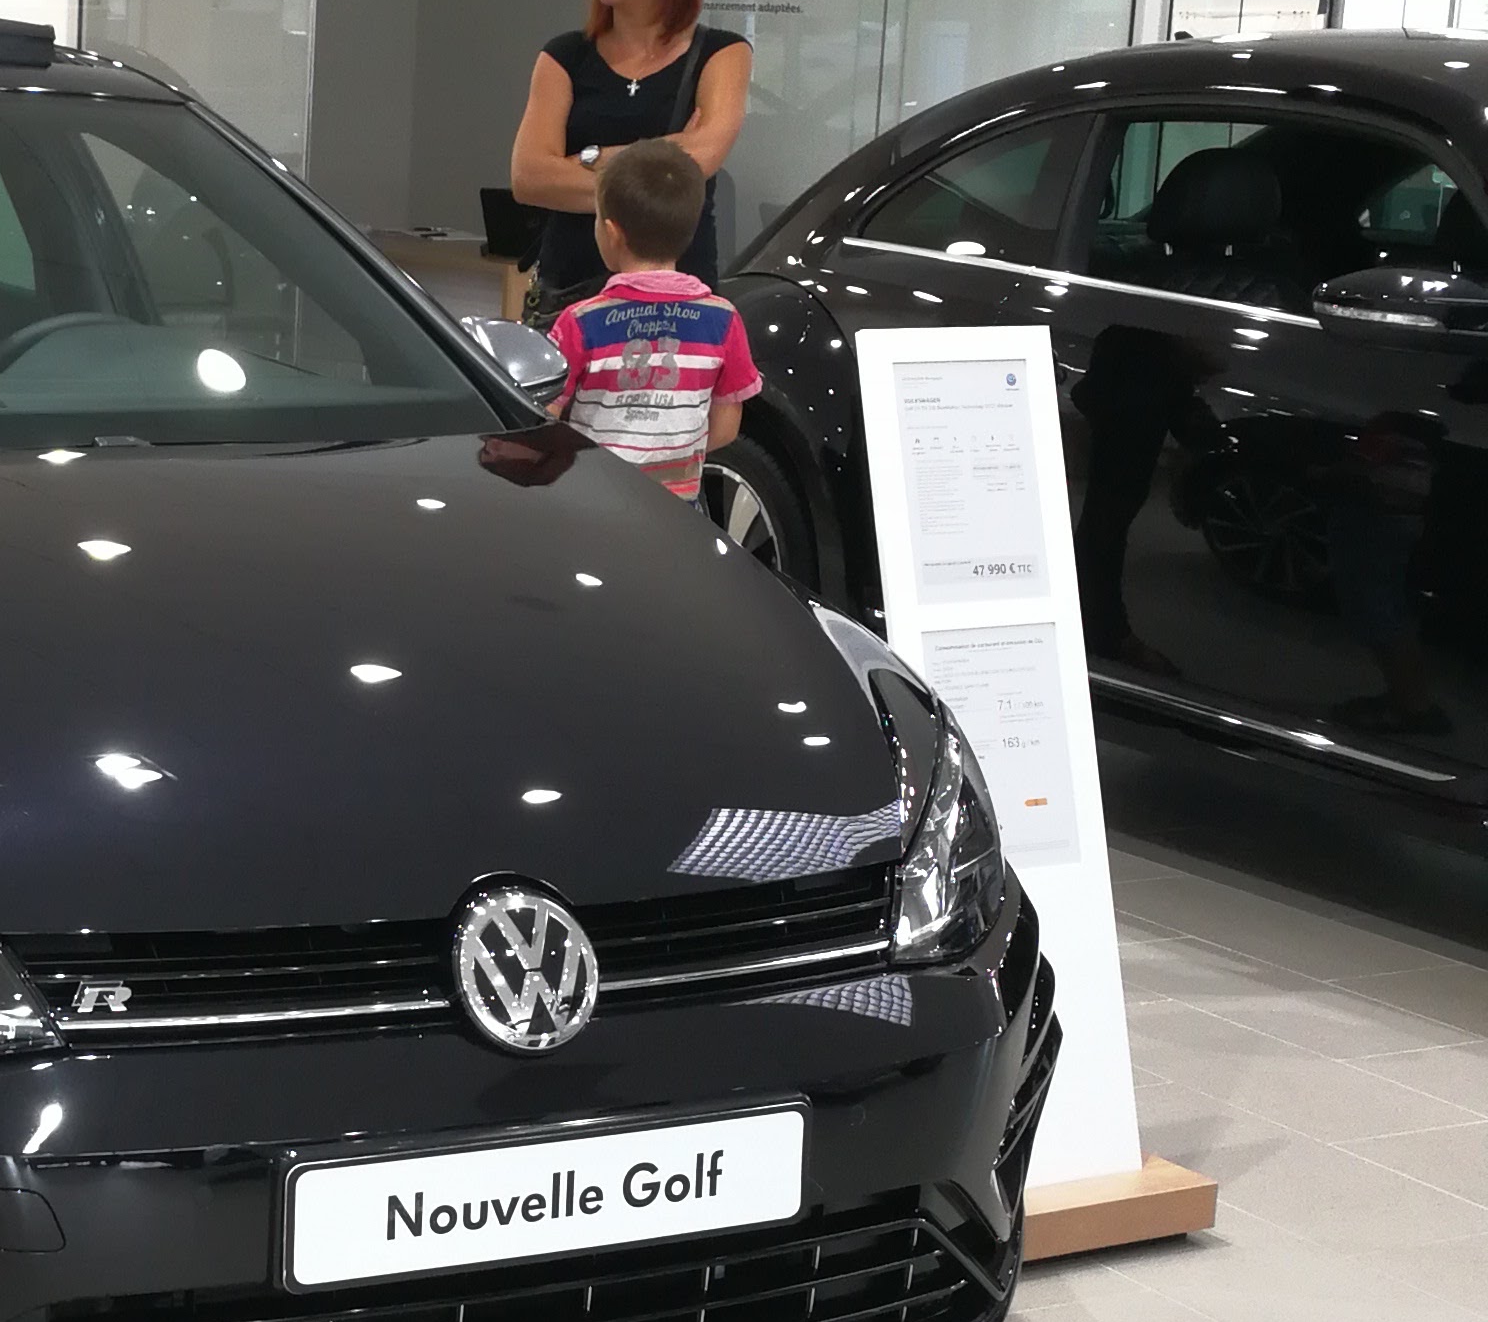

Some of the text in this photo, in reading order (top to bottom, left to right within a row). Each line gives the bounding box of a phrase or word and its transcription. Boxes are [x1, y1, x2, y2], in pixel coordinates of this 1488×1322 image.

[703, 2, 756, 12] nancement
[605, 302, 701, 325] Annual Show
[617, 336, 681, 389] 83
[973, 564, 985, 576] 47
[987, 563, 1007, 575] 990
[1009, 561, 1016, 574] €
[72, 981, 132, 1013] R
[386, 1149, 724, 1241] Nouvelle Golf
